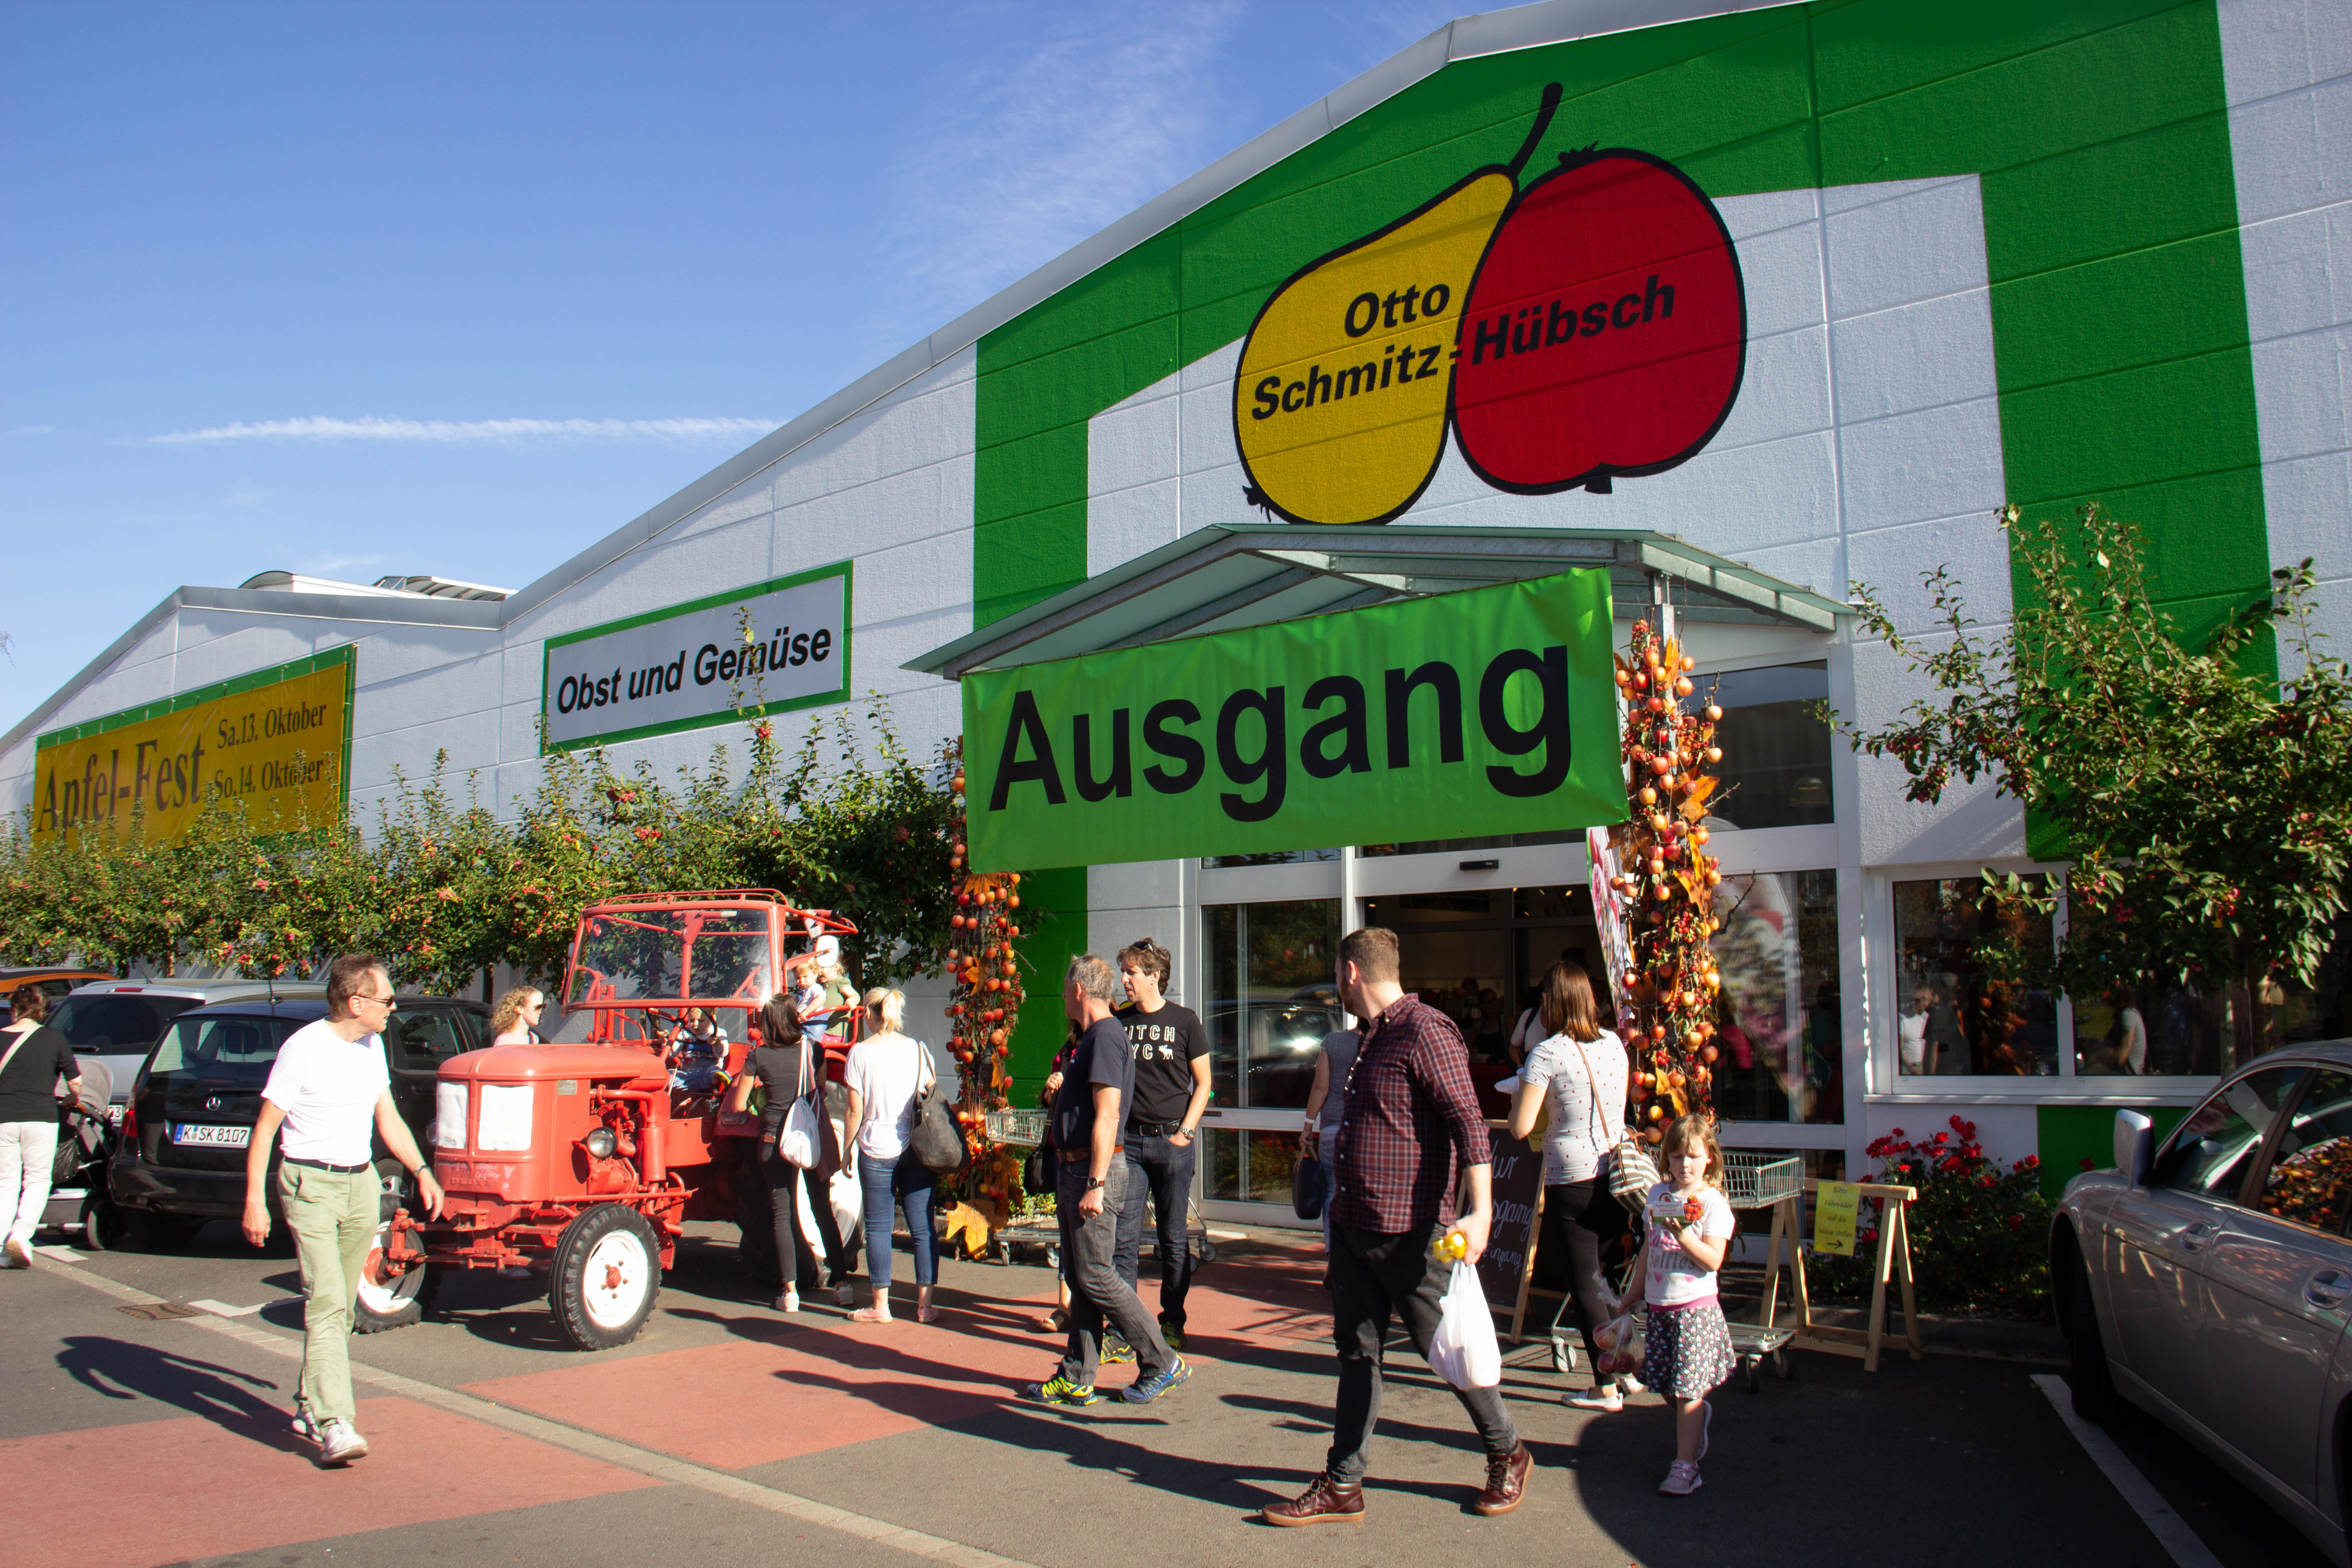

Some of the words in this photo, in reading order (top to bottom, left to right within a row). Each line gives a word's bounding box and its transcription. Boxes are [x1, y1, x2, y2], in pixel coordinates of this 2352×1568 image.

[1344, 283, 1450, 338] Otto
[558, 666, 622, 714] Obst
[628, 650, 686, 700] und
[694, 626, 831, 686] Gemüse
[265, 701, 327, 738] Oktober
[989, 645, 1571, 822] Ausgang
[36, 731, 205, 840] Apfel-Fest
[1124, 1024, 1175, 1042] ITCH
[1132, 1044, 1153, 1060] YC
[183, 1126, 192, 1140] K
[199, 1127, 216, 1142] SK
[217, 1128, 248, 1143] 8107
[1491, 1139, 1519, 1179] ur
[1467, 1199, 1534, 1242] sgang
